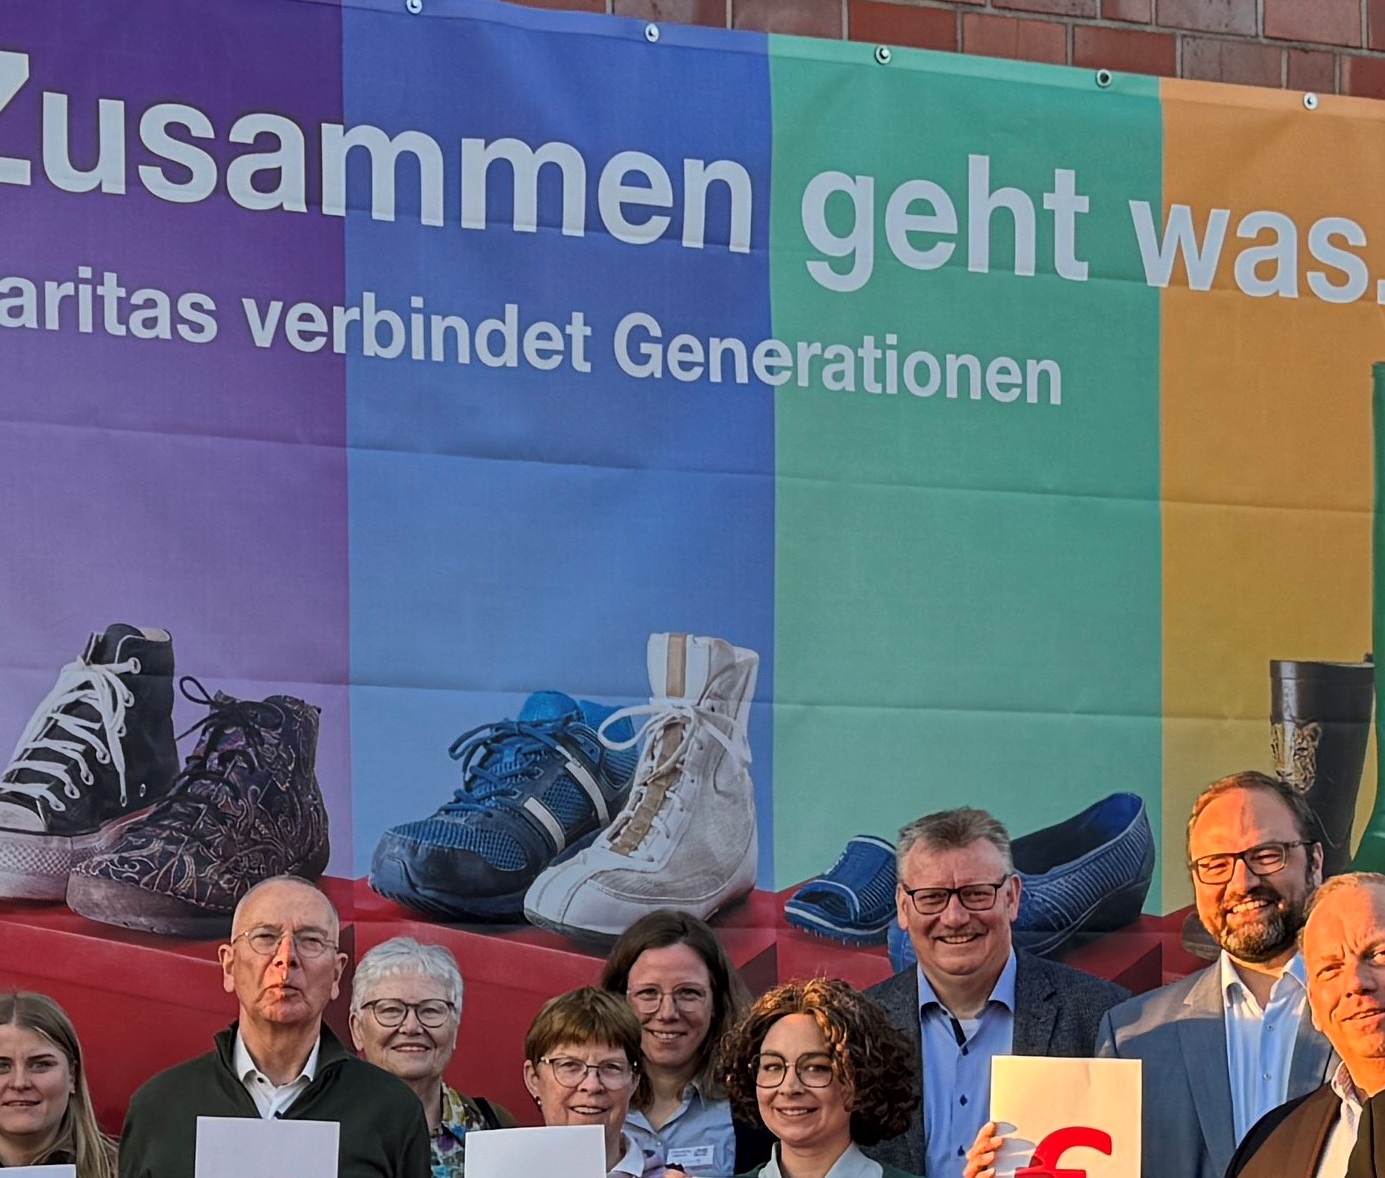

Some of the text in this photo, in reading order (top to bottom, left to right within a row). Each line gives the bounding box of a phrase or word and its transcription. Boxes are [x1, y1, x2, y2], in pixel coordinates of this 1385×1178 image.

[801, 154, 1090, 292] geht
[242, 292, 592, 373] verbindet
[613, 312, 1062, 405] Generationen
